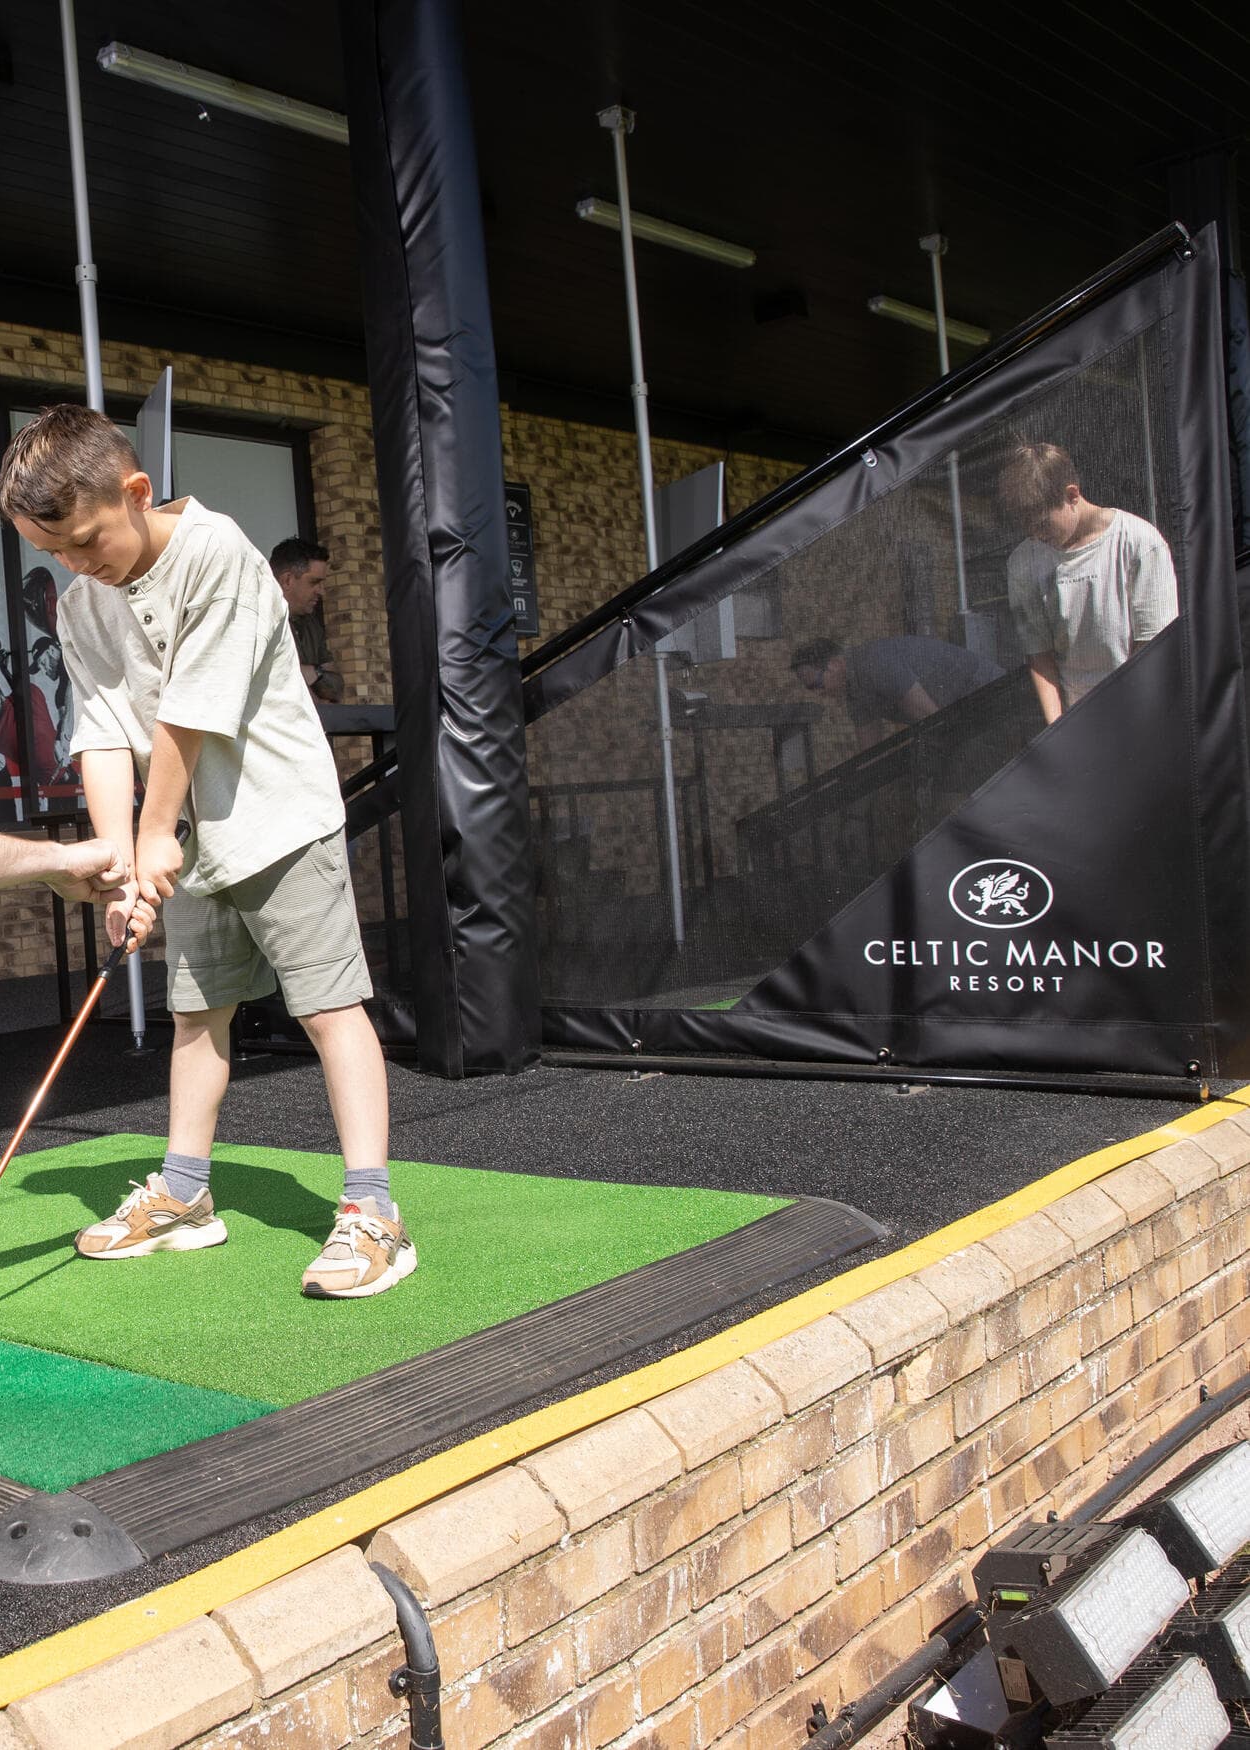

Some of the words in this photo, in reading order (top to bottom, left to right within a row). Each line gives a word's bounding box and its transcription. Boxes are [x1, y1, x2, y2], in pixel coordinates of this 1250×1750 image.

[863, 939, 989, 966] CELTIC
[1005, 939, 1167, 969] MANOR
[949, 975, 1064, 993] RESORT
